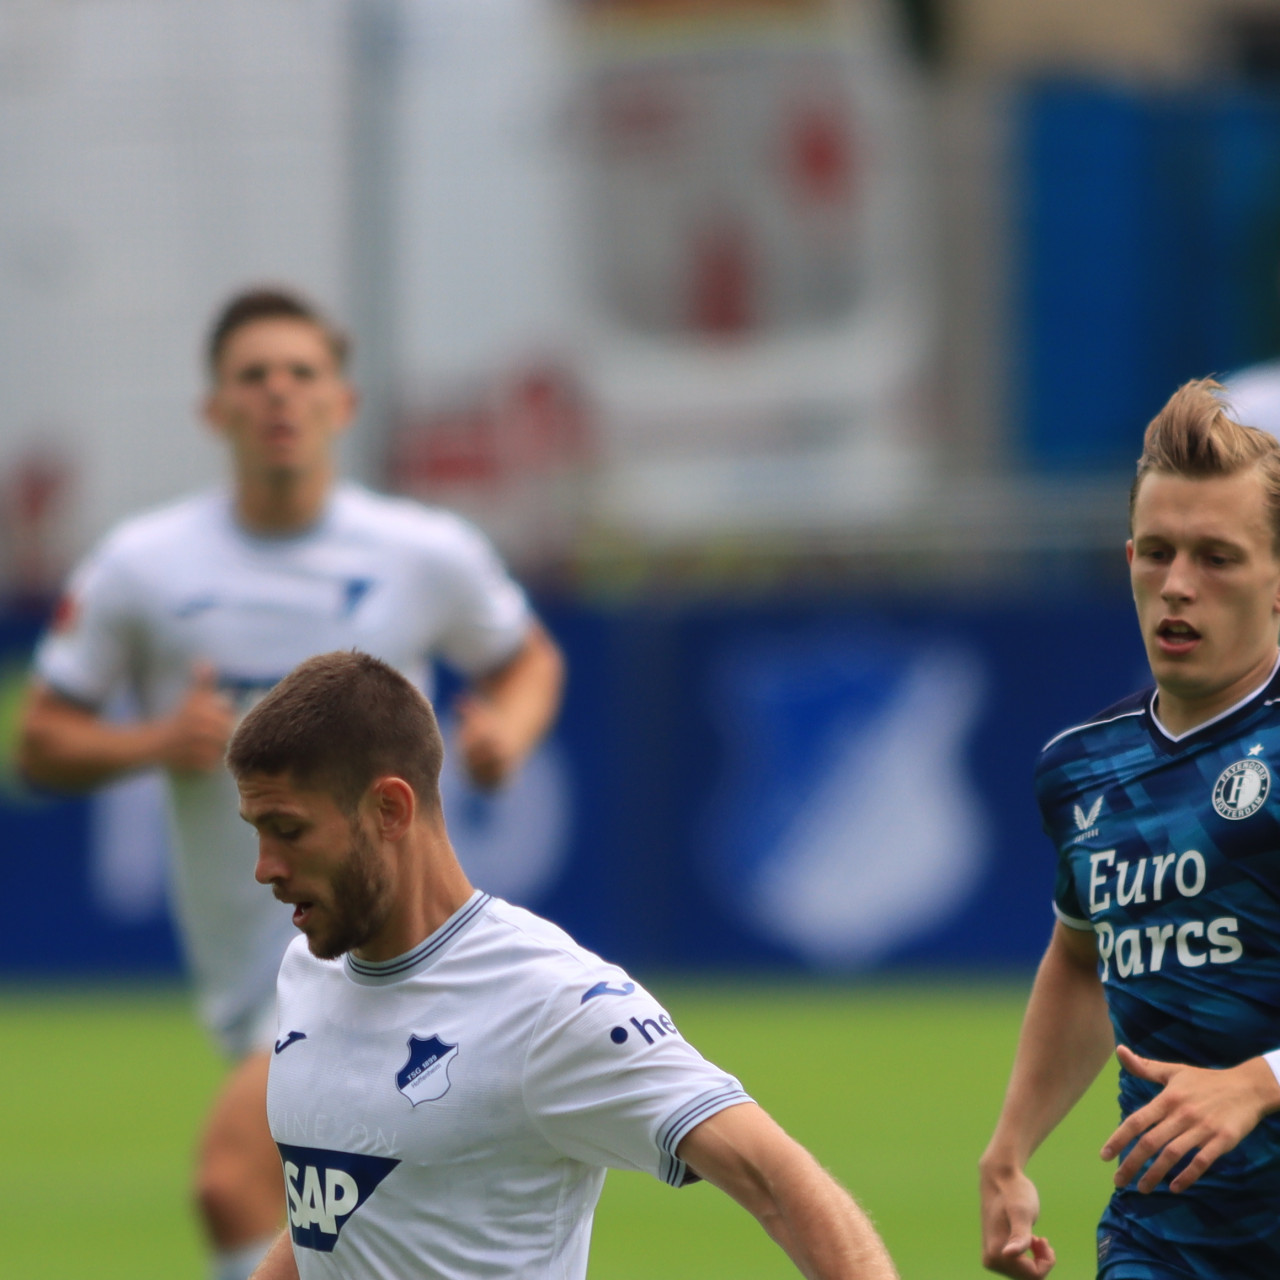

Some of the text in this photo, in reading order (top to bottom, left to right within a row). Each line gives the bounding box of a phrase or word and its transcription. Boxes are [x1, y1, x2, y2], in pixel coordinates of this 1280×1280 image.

[1215, 796, 1263, 818] ROTTERDAM
[1089, 849, 1206, 915] Euro
[1094, 917, 1243, 983] Parcs
[406, 1054, 438, 1081] TSG 1899
[272, 1112, 398, 1156] KINEON
[284, 1160, 359, 1235] SAP
